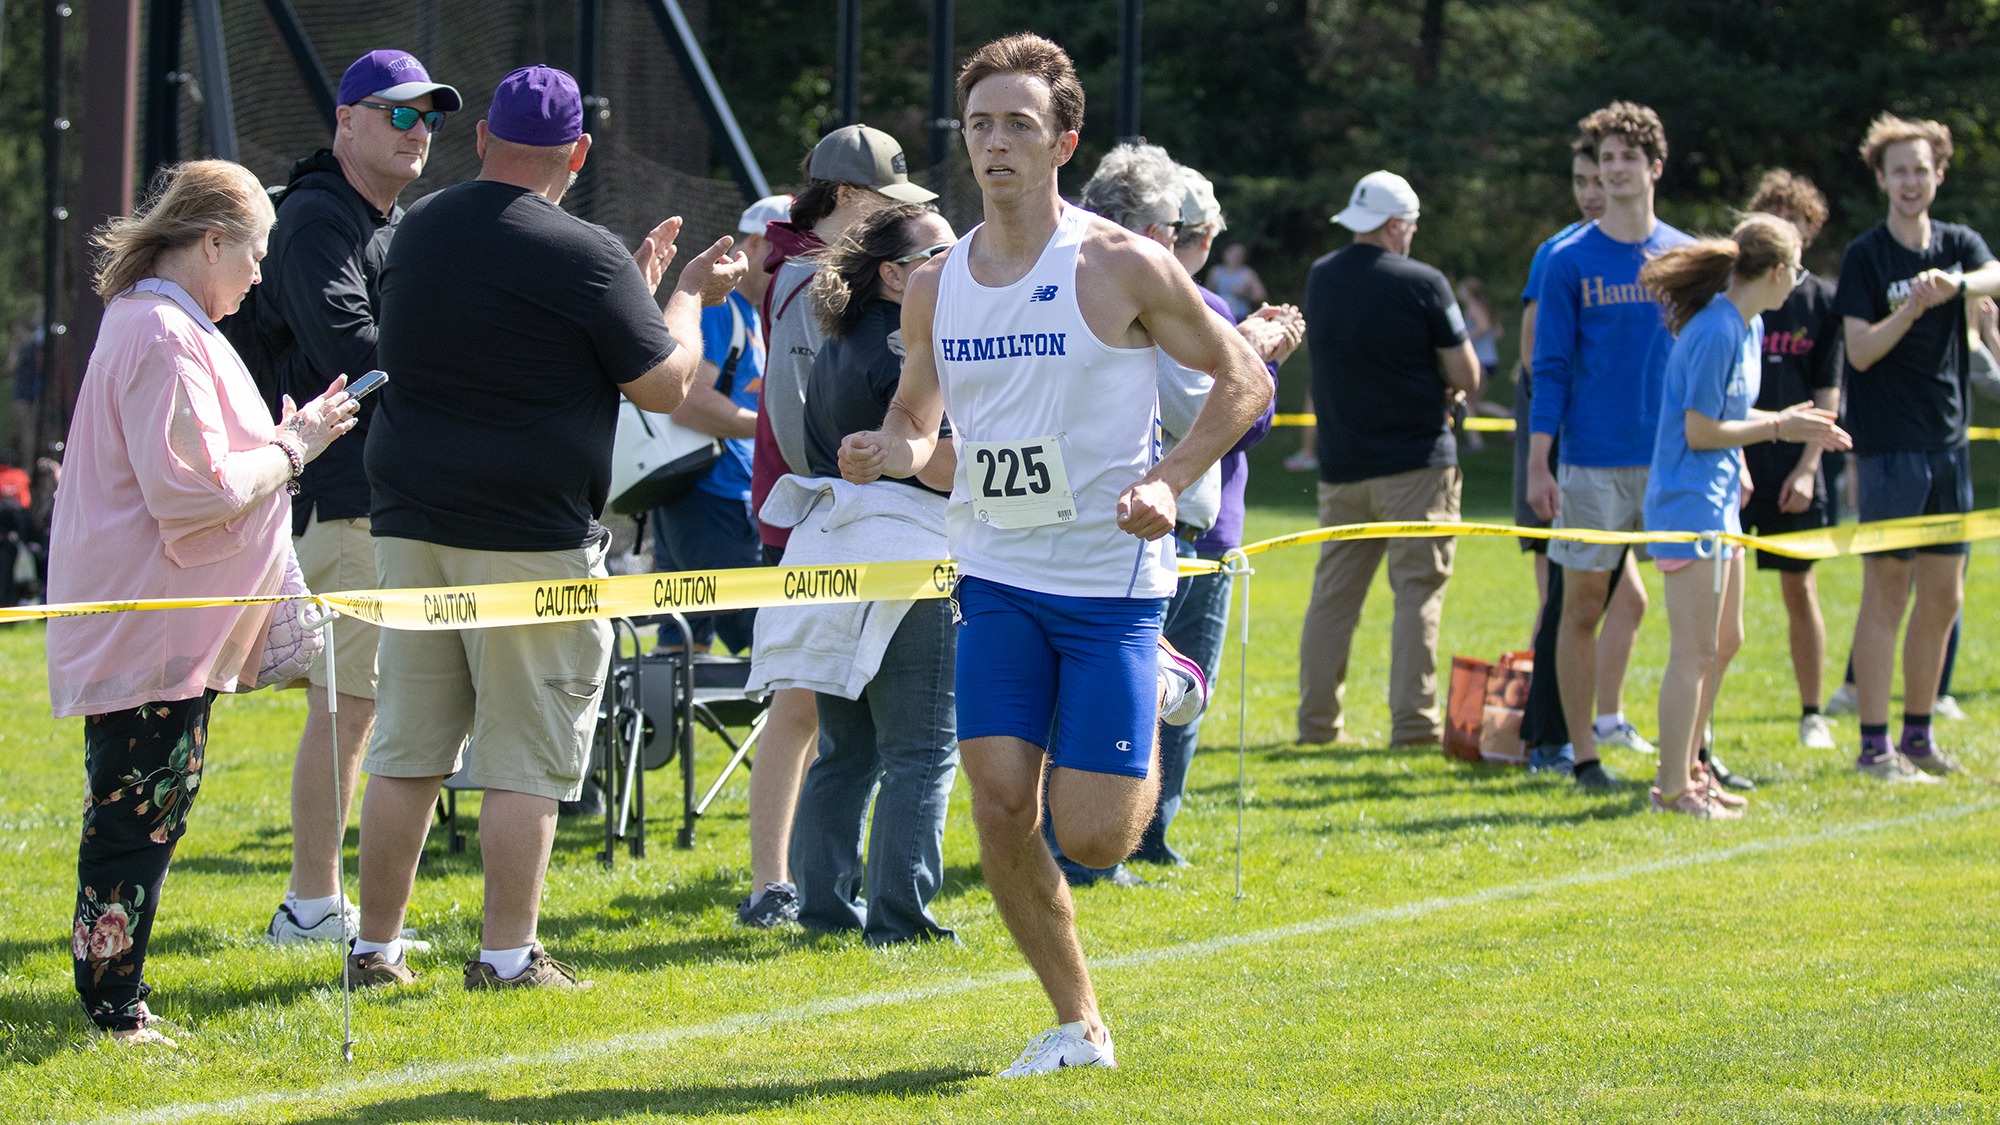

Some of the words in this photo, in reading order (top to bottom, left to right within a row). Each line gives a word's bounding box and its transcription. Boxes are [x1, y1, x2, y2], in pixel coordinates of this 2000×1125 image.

[941, 333, 1066, 362] HAMILTON
[976, 445, 1052, 498] 225
[423, 592, 478, 625] CAUTION
[534, 583, 599, 618] CAUTION
[653, 575, 717, 608] CAUTION
[784, 568, 857, 600] CAUTION
